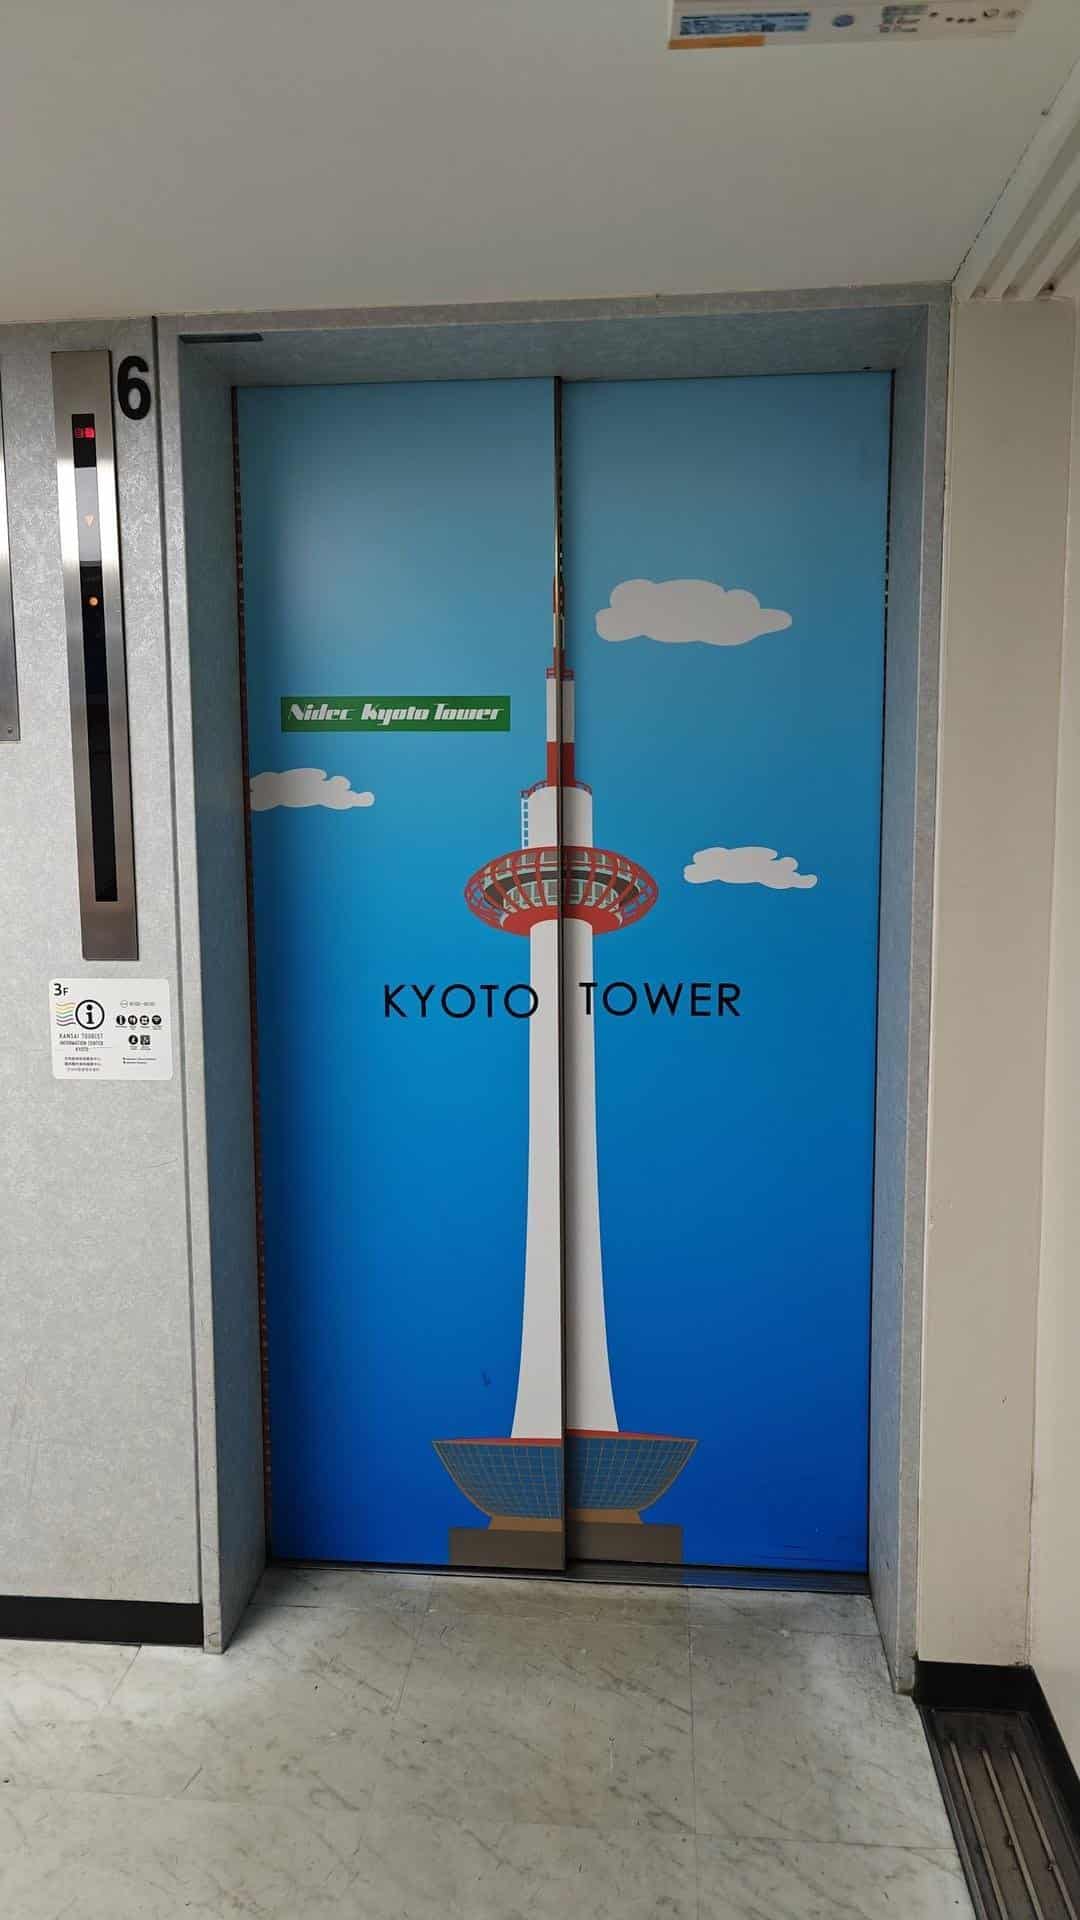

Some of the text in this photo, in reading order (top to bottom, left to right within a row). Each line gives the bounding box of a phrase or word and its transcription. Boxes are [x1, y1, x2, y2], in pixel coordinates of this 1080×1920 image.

[117, 355, 151, 420] 6
[288, 703, 505, 726] Nidec Kyoto Tower
[53, 982, 69, 997] 3F
[384, 981, 742, 1018] KYOTO TOWER
